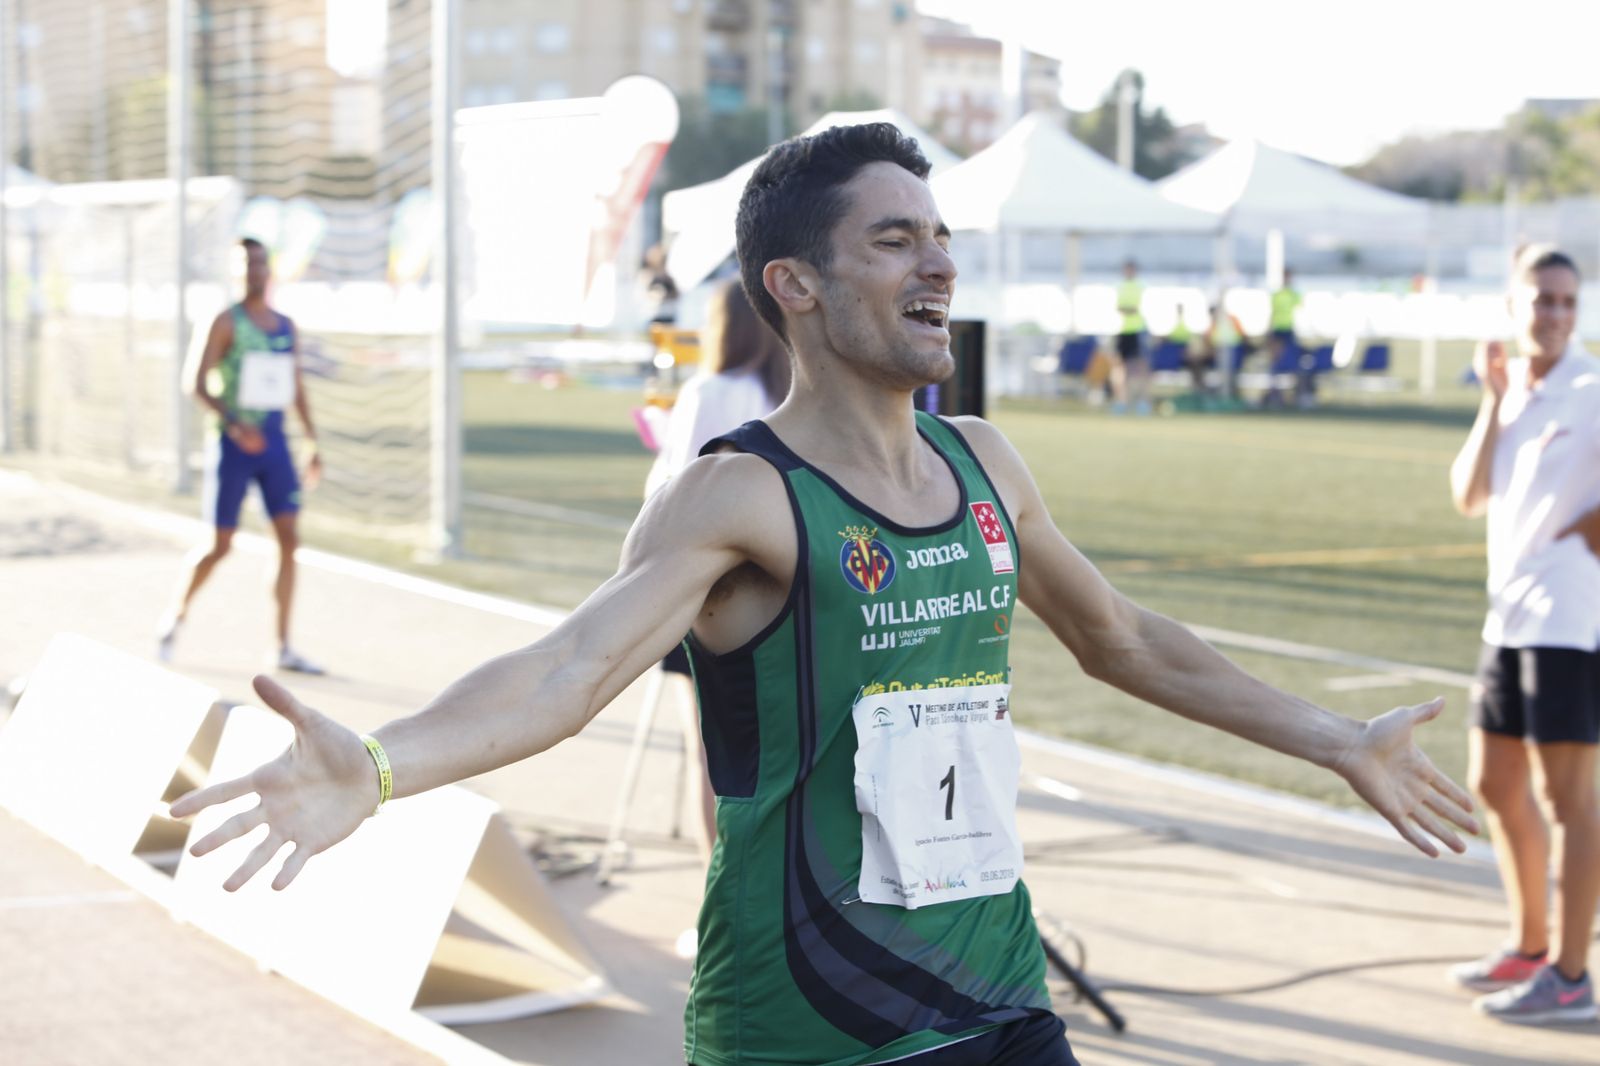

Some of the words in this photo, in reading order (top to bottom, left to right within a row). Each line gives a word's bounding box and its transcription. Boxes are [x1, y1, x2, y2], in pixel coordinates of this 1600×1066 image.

[906, 542, 969, 570] Joma
[861, 589, 987, 627] VILLARREAL
[861, 632, 896, 651] UJI
[908, 704, 922, 728] V
[948, 703, 956, 711] DE
[938, 764, 956, 821] 1
